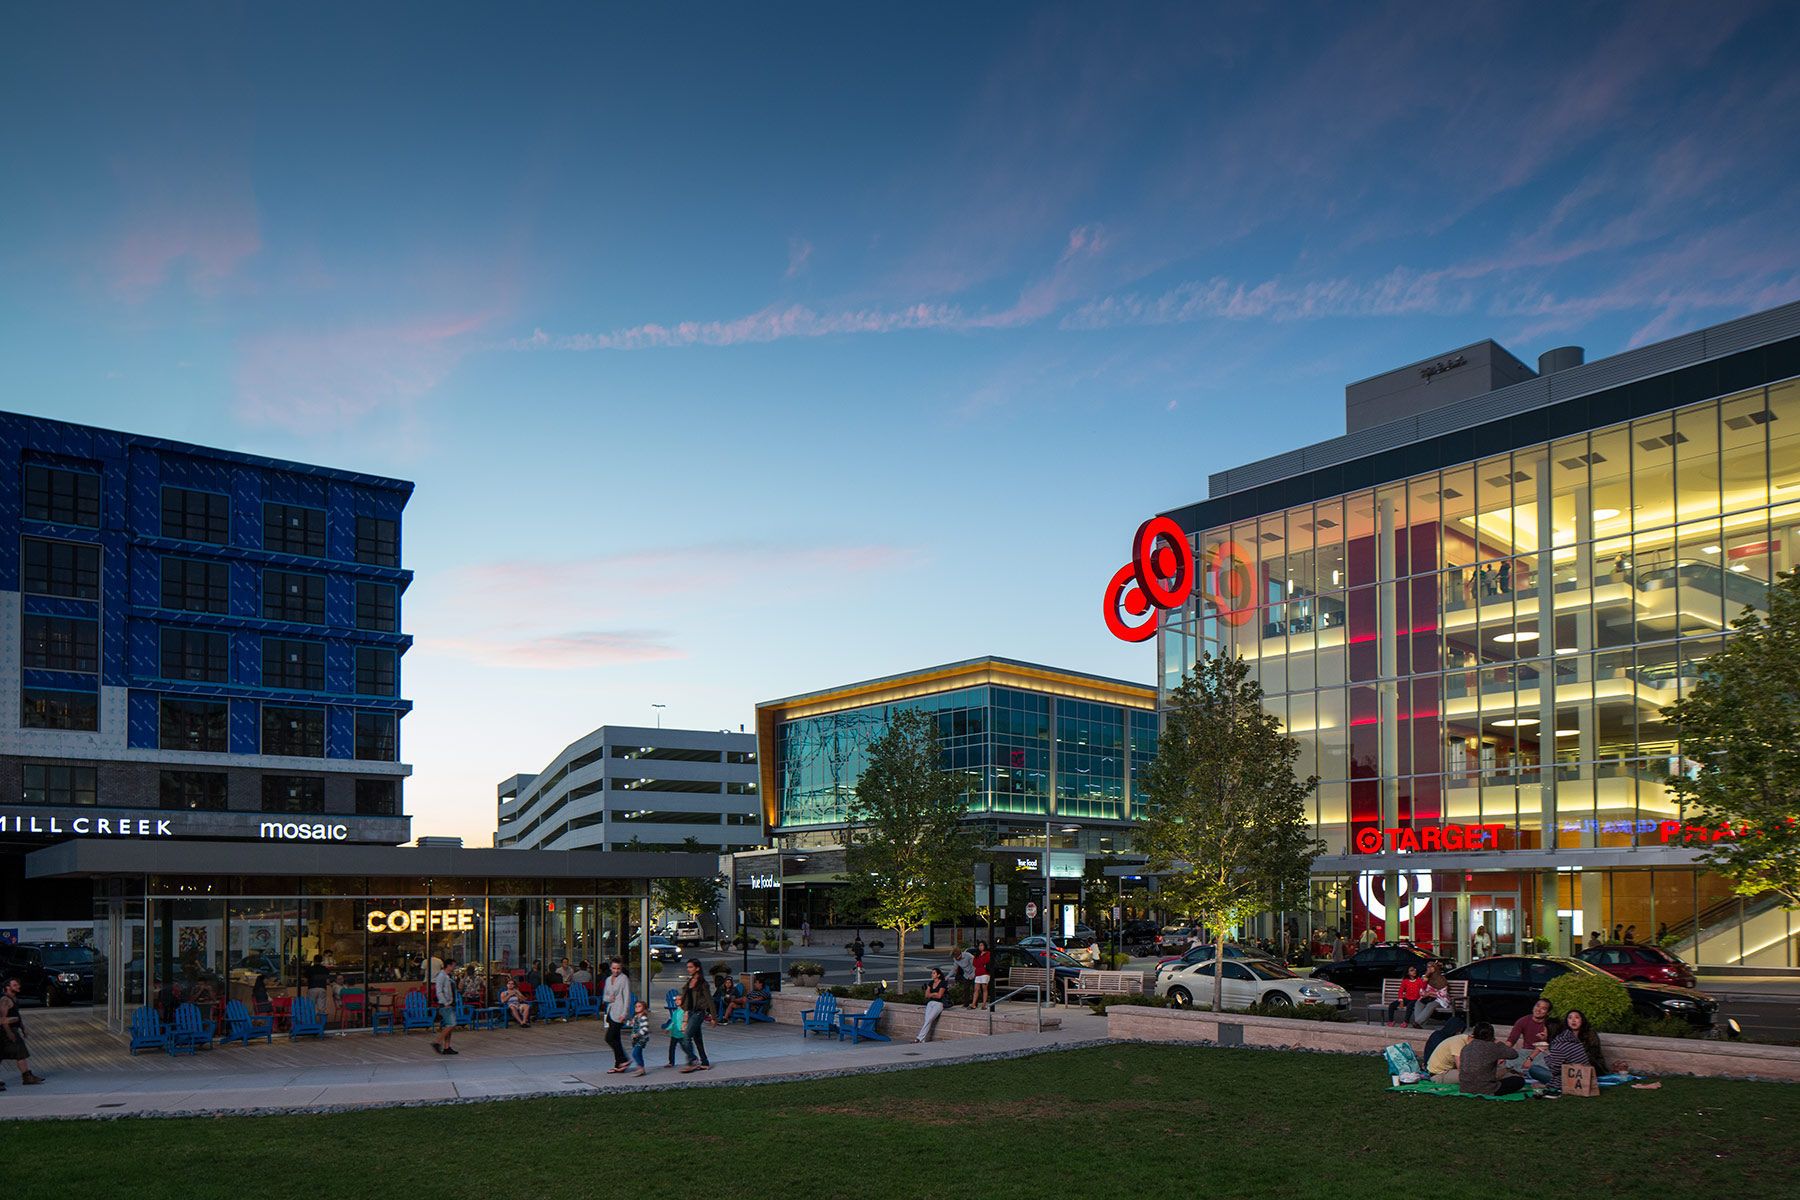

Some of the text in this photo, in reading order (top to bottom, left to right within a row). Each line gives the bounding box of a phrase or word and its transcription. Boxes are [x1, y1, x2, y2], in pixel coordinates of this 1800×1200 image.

[72, 817, 172, 836] CREEK
[260, 822, 348, 840] mosaic
[1383, 823, 1506, 851] TARGET
[760, 874, 774, 889] Food
[367, 909, 475, 933] COFFEE
